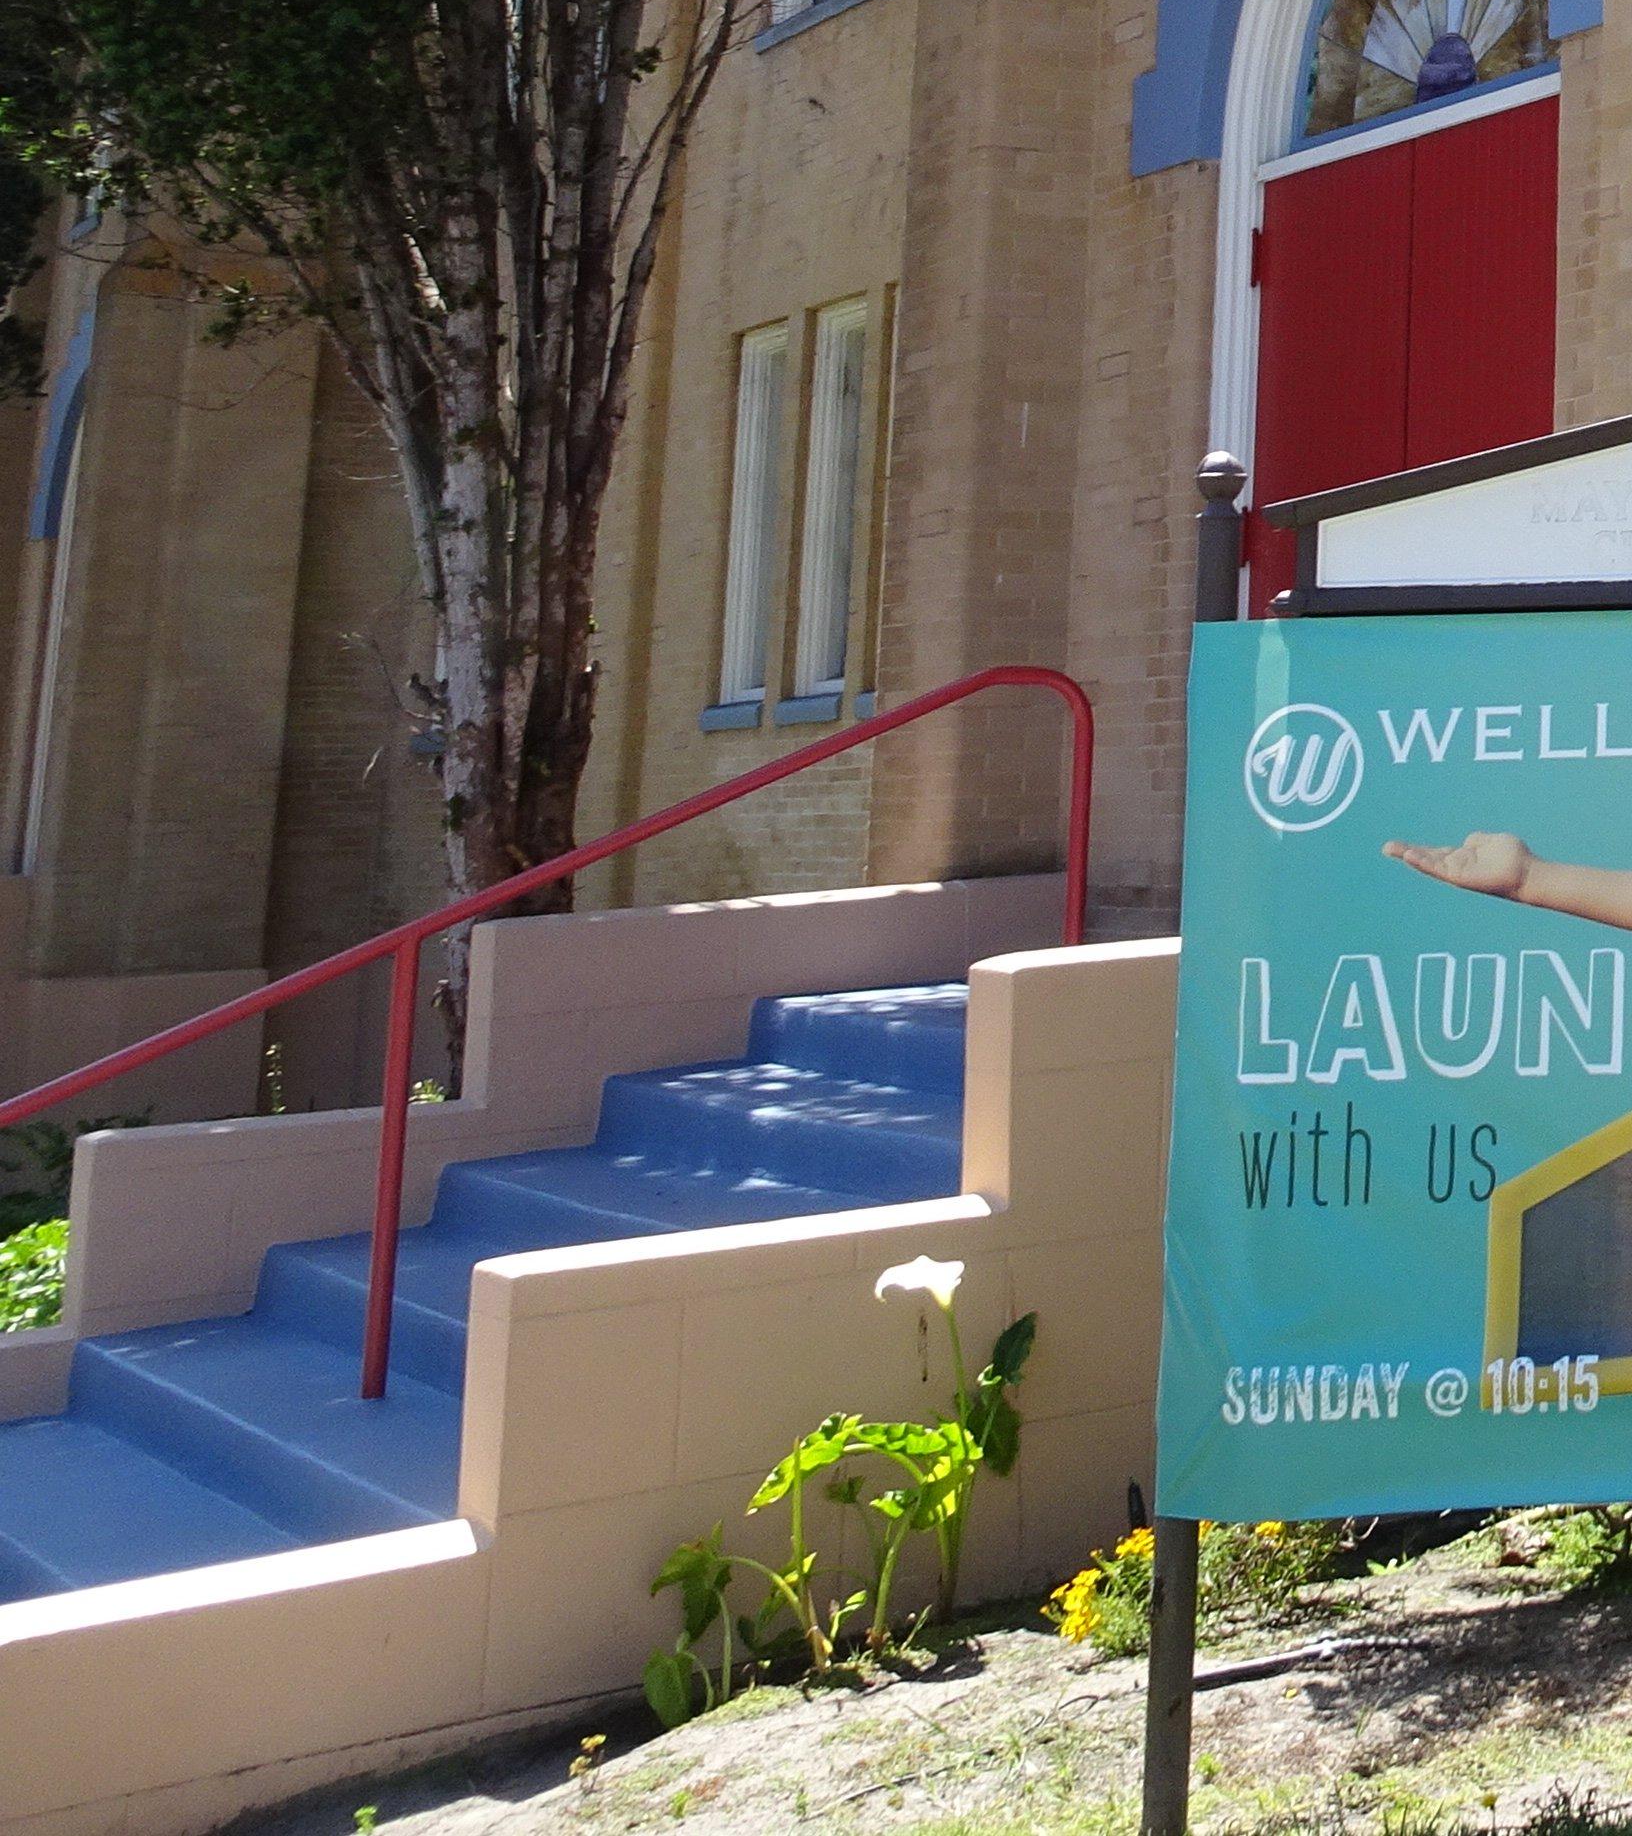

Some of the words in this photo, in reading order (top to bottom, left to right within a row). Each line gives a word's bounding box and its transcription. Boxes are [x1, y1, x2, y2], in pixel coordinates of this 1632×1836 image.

[1240, 1101, 1373, 1209] with
[1221, 1363, 1409, 1427] SUNDAY
[1425, 1367, 1468, 1417] @
[1485, 1355, 1600, 1415] 10:15
